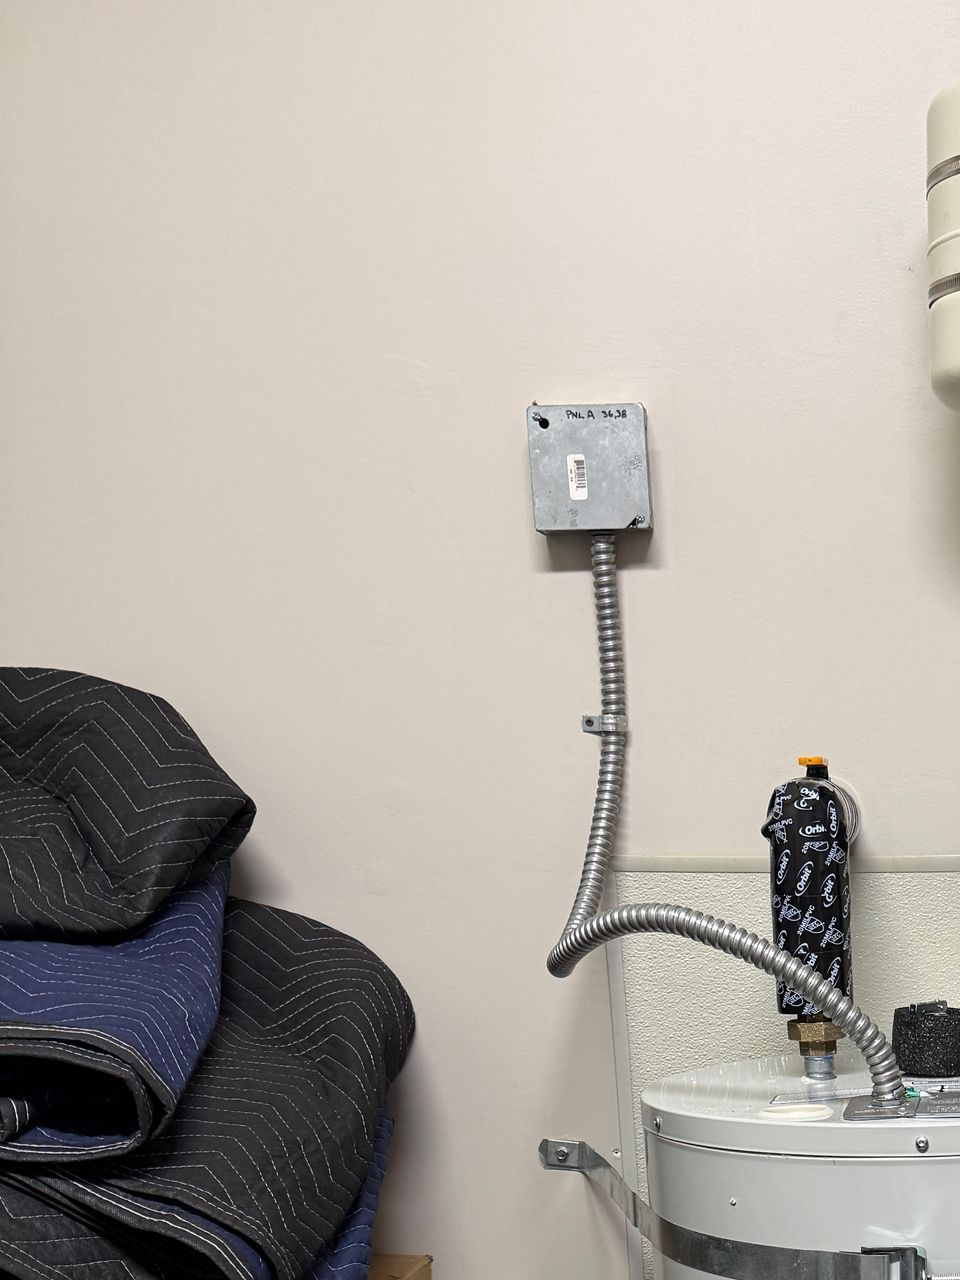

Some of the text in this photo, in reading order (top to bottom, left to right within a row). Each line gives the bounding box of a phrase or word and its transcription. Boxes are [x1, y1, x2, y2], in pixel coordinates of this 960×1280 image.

[566, 410, 585, 419] PNL
[587, 410, 595, 419] A
[778, 855, 789, 878] Orbit
[797, 866, 812, 891] Orbit
